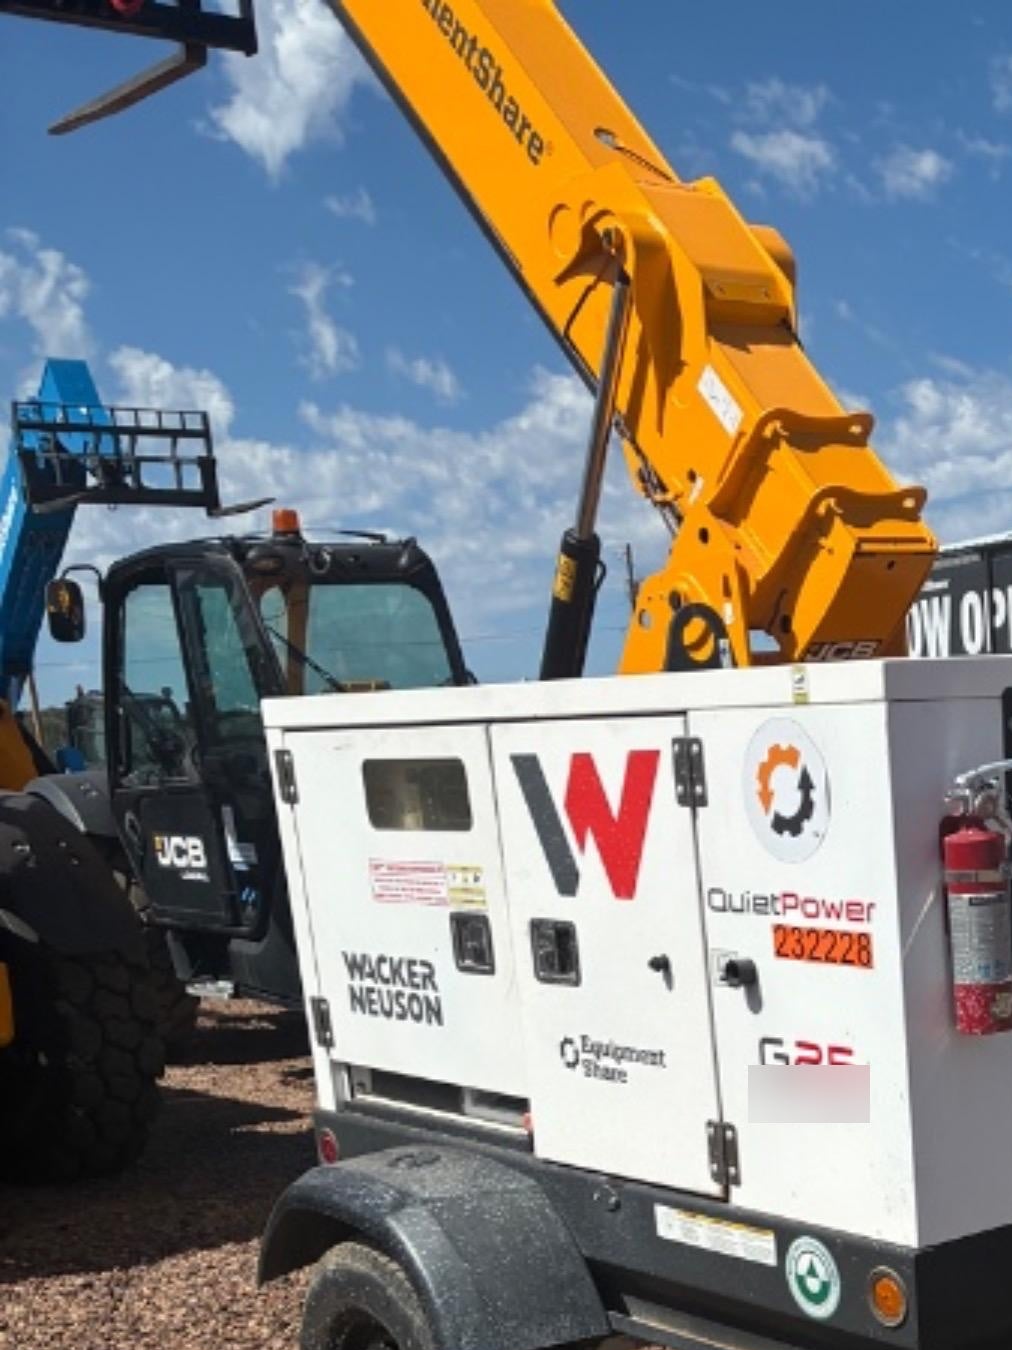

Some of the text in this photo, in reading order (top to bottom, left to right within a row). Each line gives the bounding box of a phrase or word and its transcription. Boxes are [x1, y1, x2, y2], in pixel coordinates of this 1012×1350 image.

[906, 596, 951, 657] OW
[806, 641, 878, 660] JCB
[155, 836, 207, 868] JCB
[707, 887, 876, 923] QuietPower
[772, 925, 873, 968] 232228
[341, 950, 438, 993] WACKER
[348, 984, 444, 1026] NEUSON
